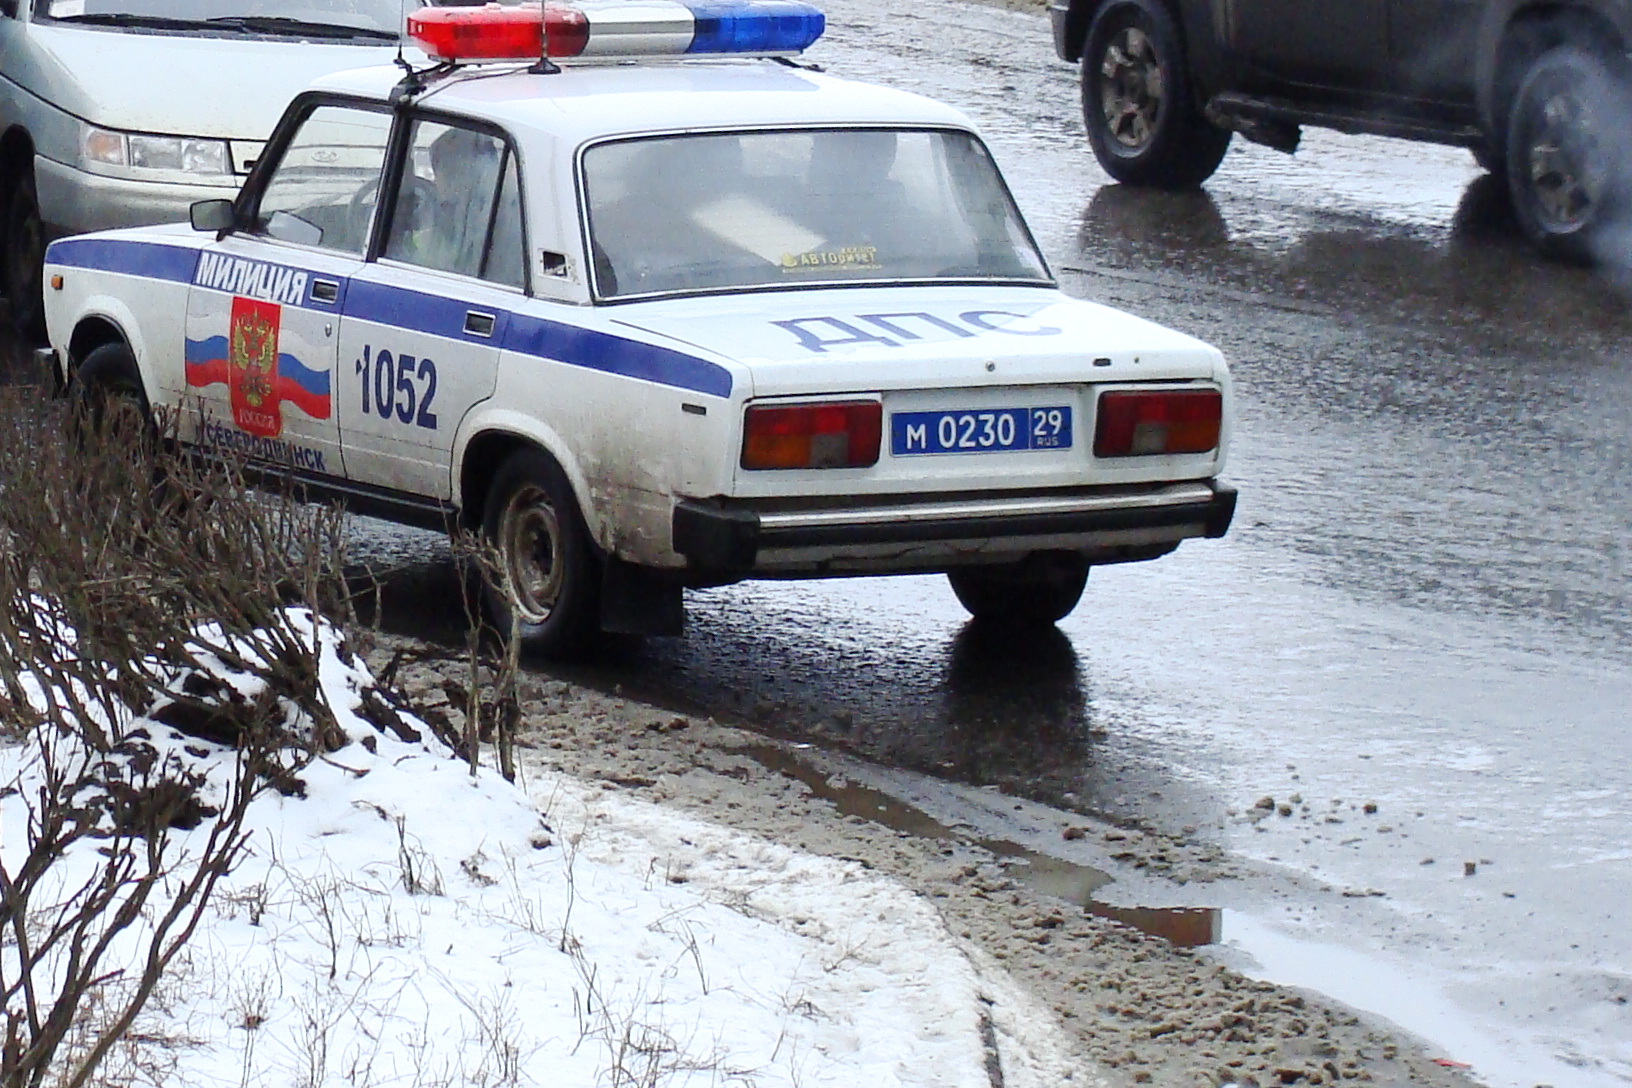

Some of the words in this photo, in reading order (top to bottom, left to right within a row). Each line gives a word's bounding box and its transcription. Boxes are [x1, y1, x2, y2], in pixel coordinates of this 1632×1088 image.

[196, 252, 309, 306] МИЛИЦИЯ
[769, 310, 1063, 352] ДПС
[355, 344, 438, 430] 1052
[906, 423, 927, 450] М
[937, 412, 1015, 449] 0230
[1033, 409, 1063, 436] 29
[1037, 436, 1060, 447] RUS
